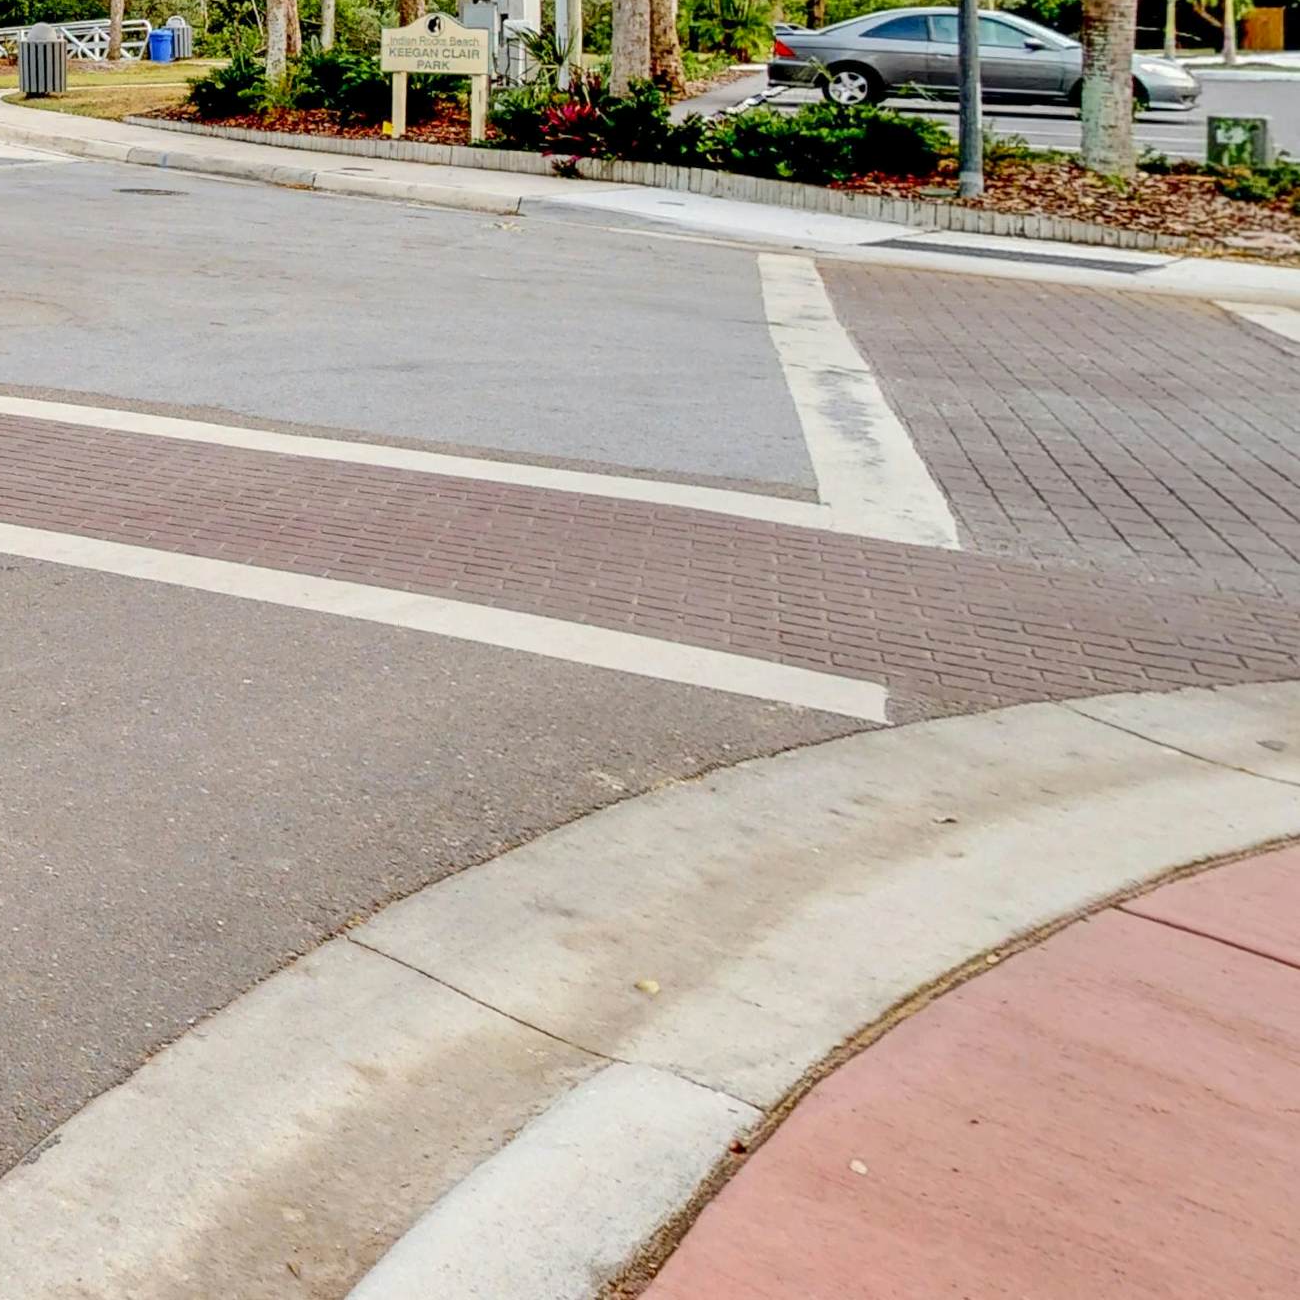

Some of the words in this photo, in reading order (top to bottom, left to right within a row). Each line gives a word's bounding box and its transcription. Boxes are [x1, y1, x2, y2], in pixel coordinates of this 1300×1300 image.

[449, 36, 480, 47] Beach
[389, 47, 439, 58] KEEGAN
[442, 48, 480, 59] CLAIR
[416, 60, 450, 70] PARK
